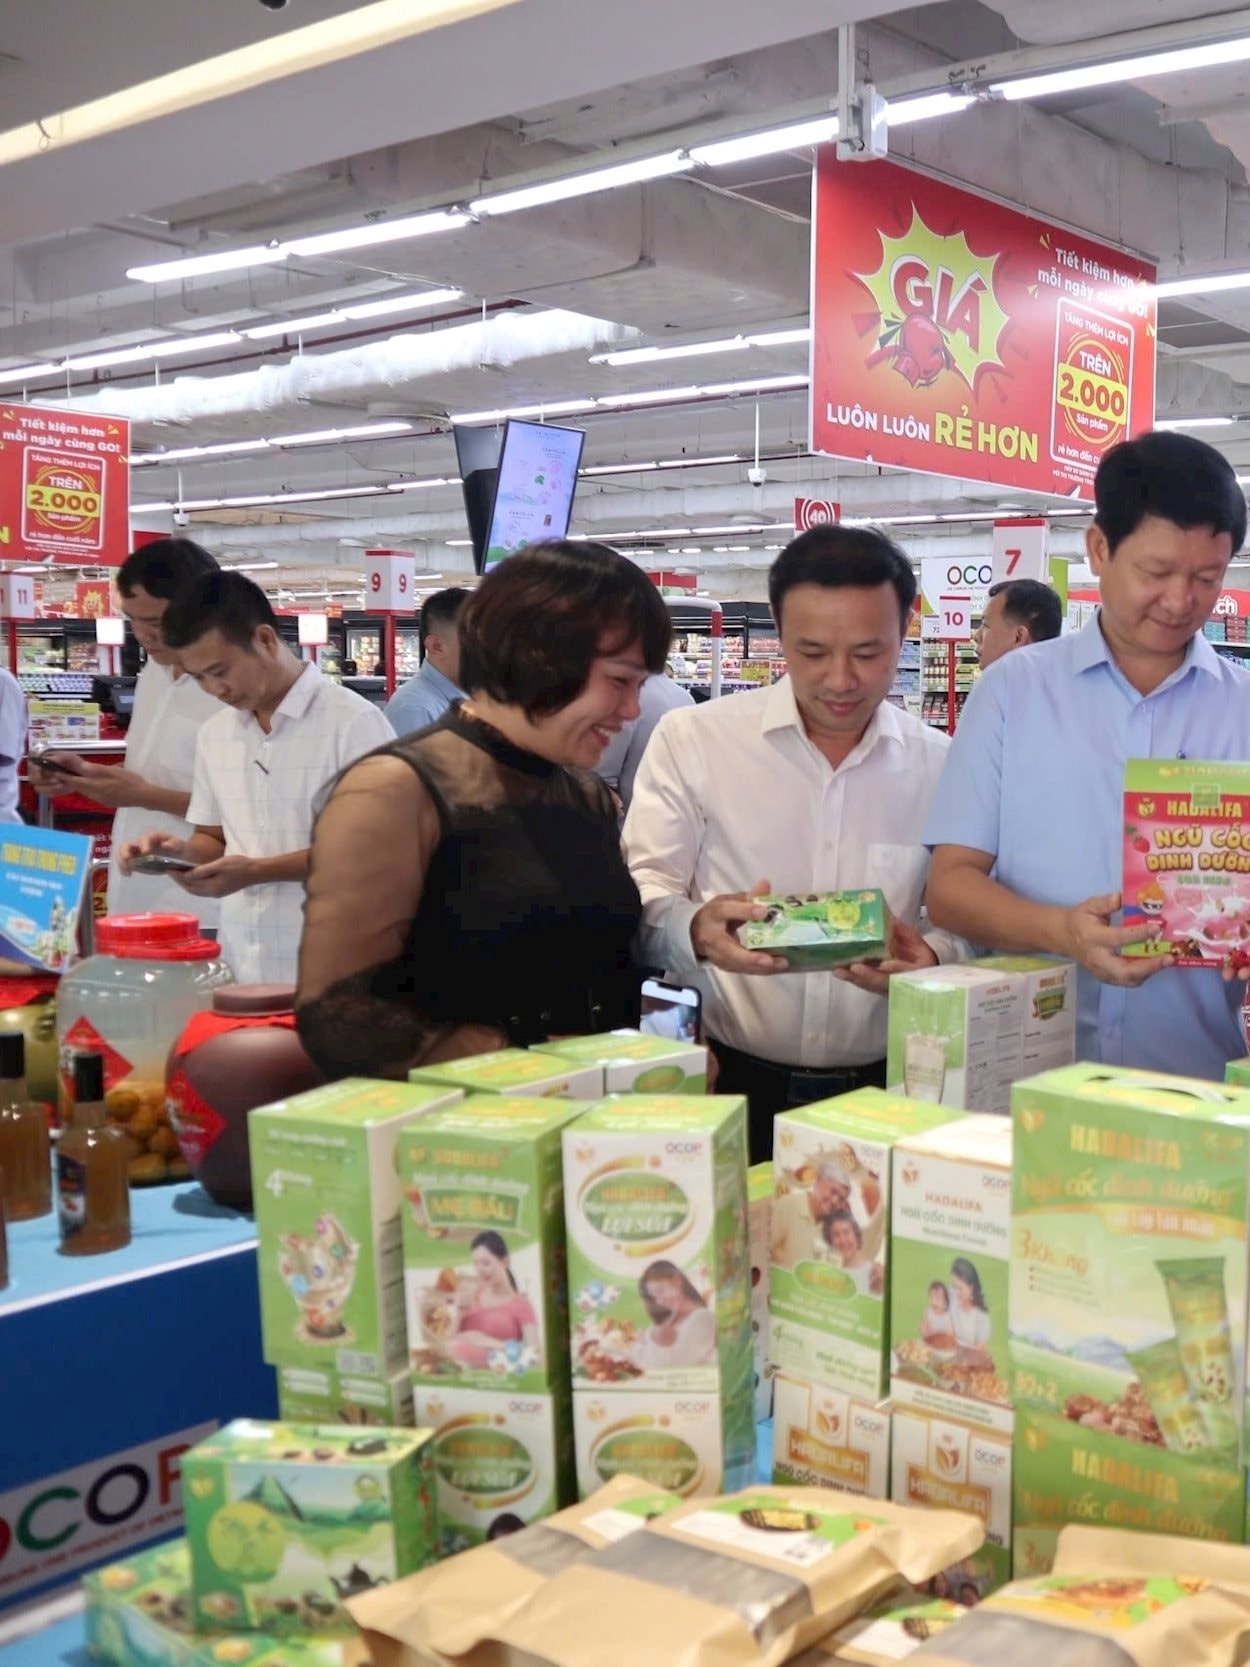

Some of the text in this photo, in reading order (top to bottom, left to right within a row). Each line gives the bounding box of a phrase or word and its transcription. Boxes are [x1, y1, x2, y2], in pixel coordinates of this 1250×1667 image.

[1055, 248, 1079, 270] Tiết
[1083, 256, 1110, 281] kiệm
[1038, 266, 1094, 299] mỗi ngày
[891, 255, 988, 351] GIÁ
[1079, 351, 1112, 377] TRÊN
[1060, 372, 1125, 417] 2.000
[20, 417, 105, 437] Tiết kiệm hơn
[826, 402, 1039, 464] LUÔN LUÔN RẺ HƠN
[3, 429, 28, 442] mỗi
[31, 434, 62, 448] ngày
[65, 438, 95, 450] cùng
[49, 475, 83, 490] TRÊN
[30, 490, 97, 513] 2.000
[1005, 549, 1022, 576] 7
[371, 571, 382, 592] 9
[399, 573, 407, 593] 9
[17, 589, 28, 603] 11
[944, 612, 963, 626] 10
[1154, 823, 1203, 849] NGŨ
[1146, 852, 1193, 873] DINH
